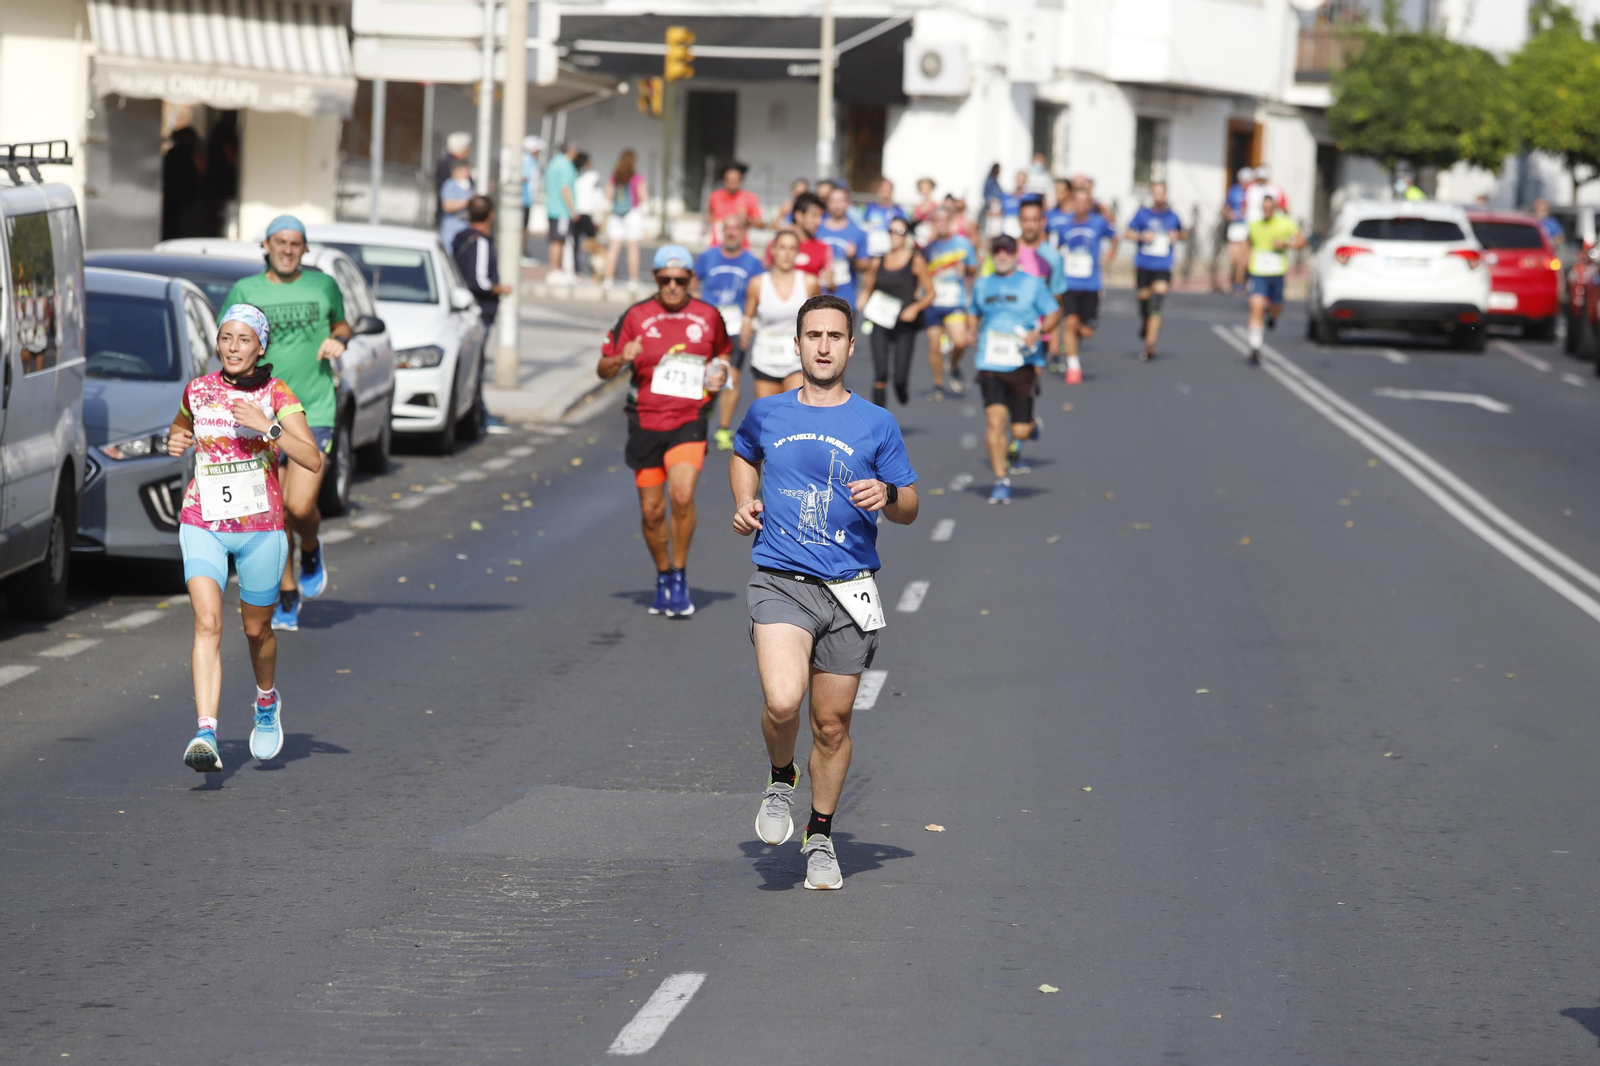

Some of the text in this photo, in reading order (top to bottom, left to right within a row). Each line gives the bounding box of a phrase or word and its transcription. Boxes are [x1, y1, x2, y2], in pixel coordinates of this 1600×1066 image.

[663, 370, 687, 385] 473
[786, 433, 817, 442] VUELTA
[817, 434, 825, 442] A
[825, 435, 855, 457] HUELVA
[209, 464, 230, 475] VUELTA
[230, 463, 236, 473] A
[222, 485, 232, 503] 5
